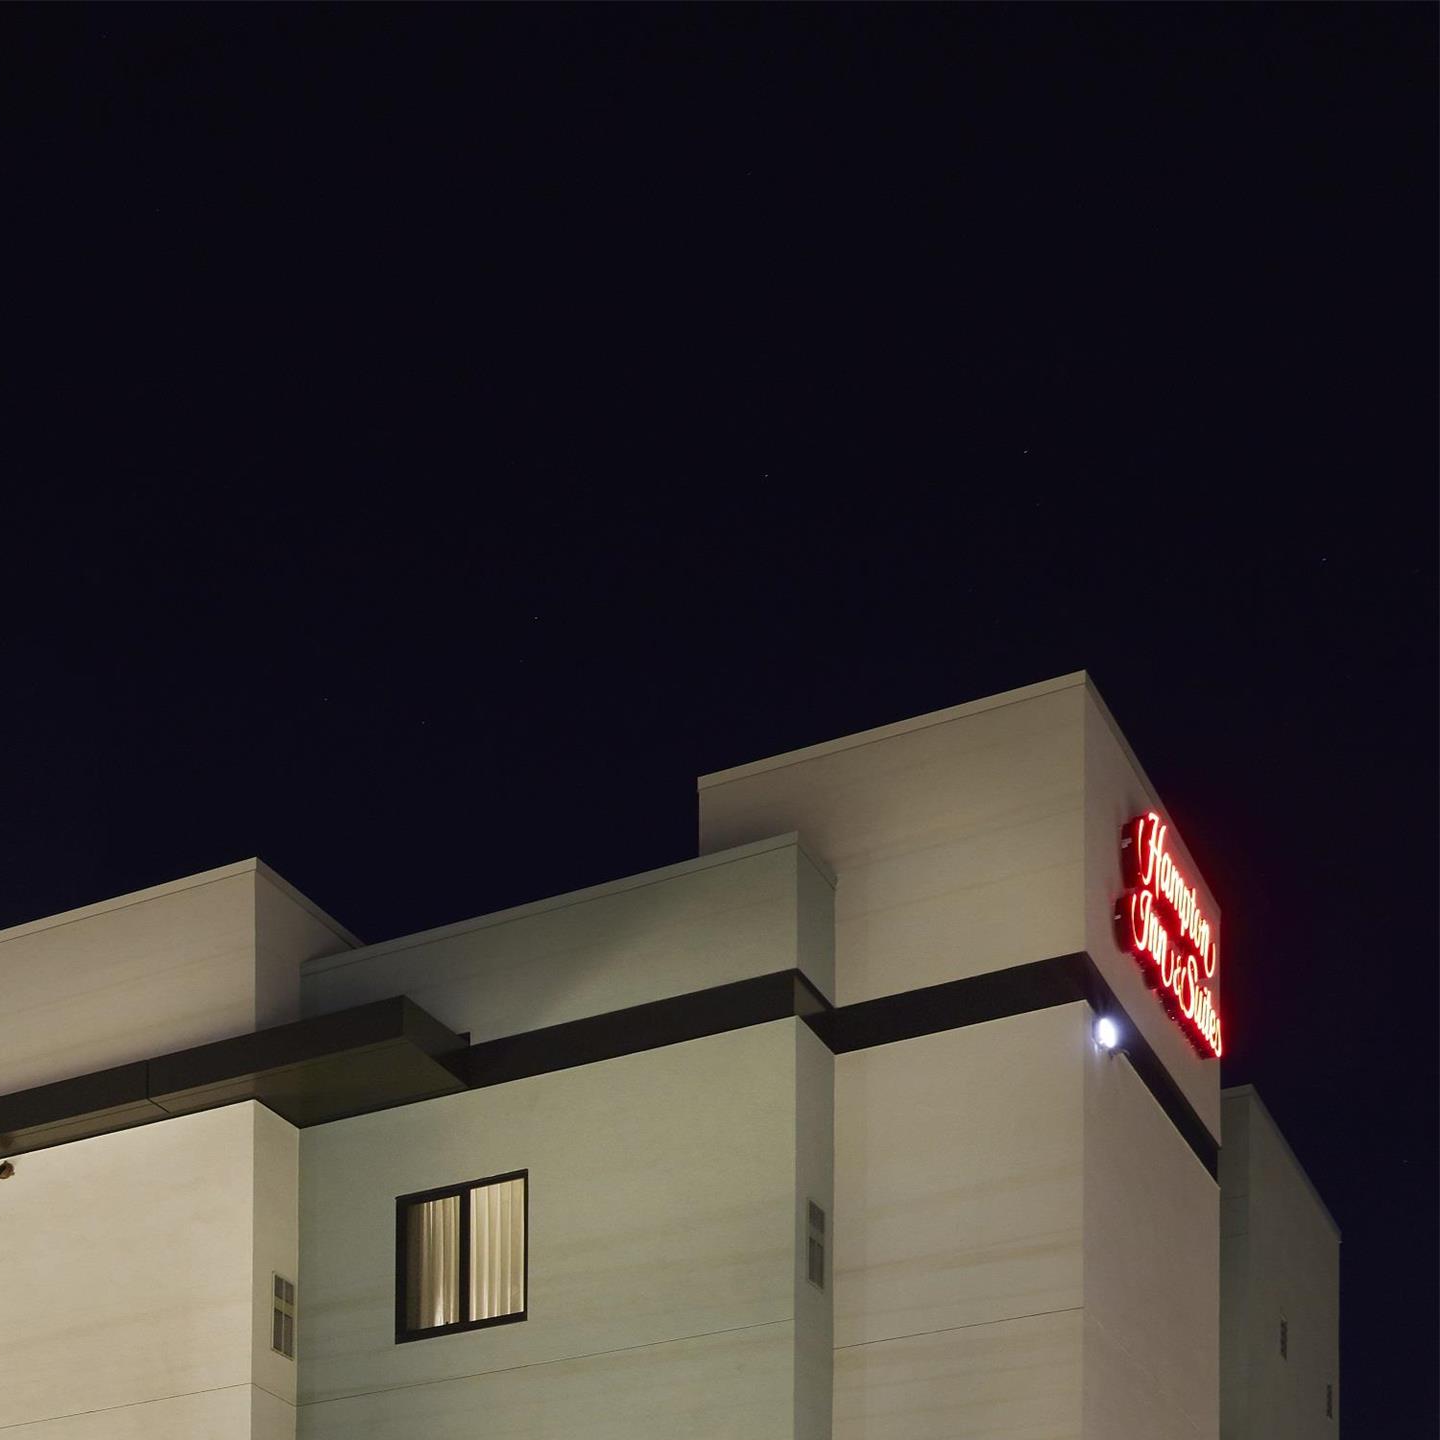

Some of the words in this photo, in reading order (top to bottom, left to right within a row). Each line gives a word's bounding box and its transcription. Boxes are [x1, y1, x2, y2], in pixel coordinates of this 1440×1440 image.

[1131, 889, 1174, 988] Inn
[1178, 954, 1222, 1057] Suites
[1137, 812, 1216, 978] Hampton
